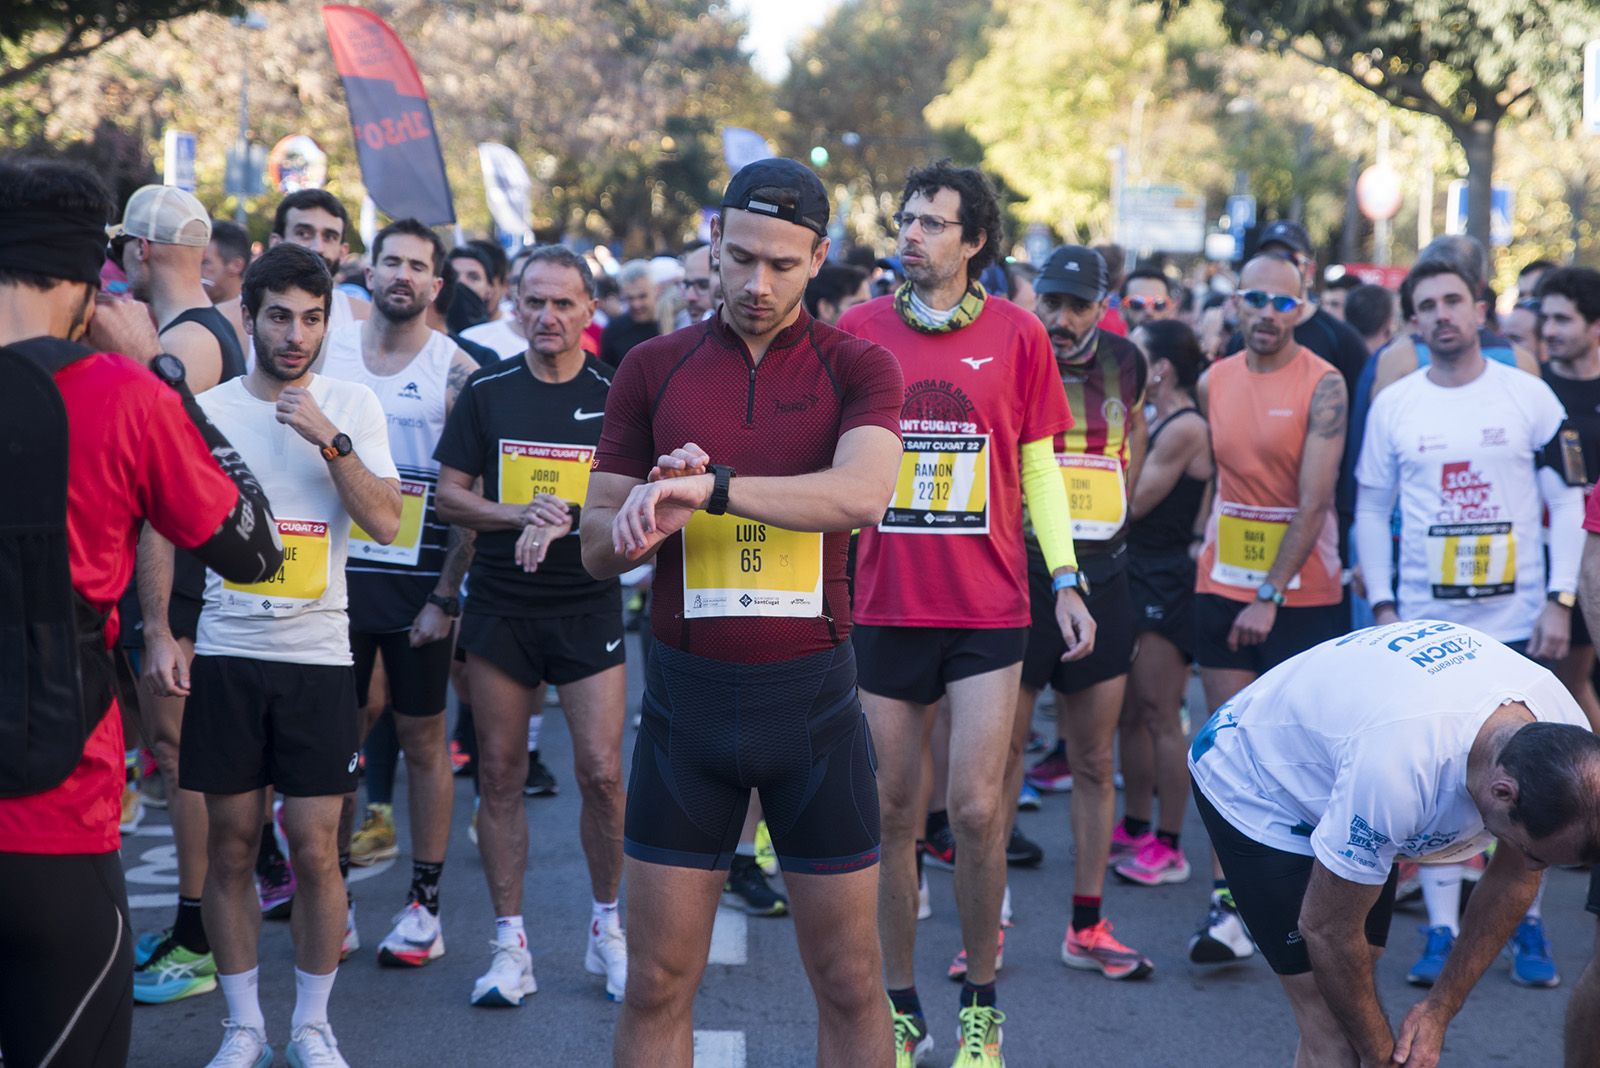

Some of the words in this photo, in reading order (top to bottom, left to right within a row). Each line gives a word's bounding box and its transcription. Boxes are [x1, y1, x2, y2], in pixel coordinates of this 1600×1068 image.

[938, 380, 954, 392] DE
[528, 447, 551, 457] SANT
[906, 441, 932, 451] SANT
[932, 441, 966, 451] CUGAT
[967, 442, 980, 451] 22
[530, 469, 560, 483] JORDI
[914, 463, 953, 478] RAMON
[918, 482, 951, 501] 2212
[280, 522, 313, 533] CUGAT
[313, 524, 326, 534] 22
[736, 524, 767, 543] LUIS
[740, 548, 762, 573] 65
[1387, 623, 1456, 653] 2XU
[1427, 655, 1465, 675] eDreams
